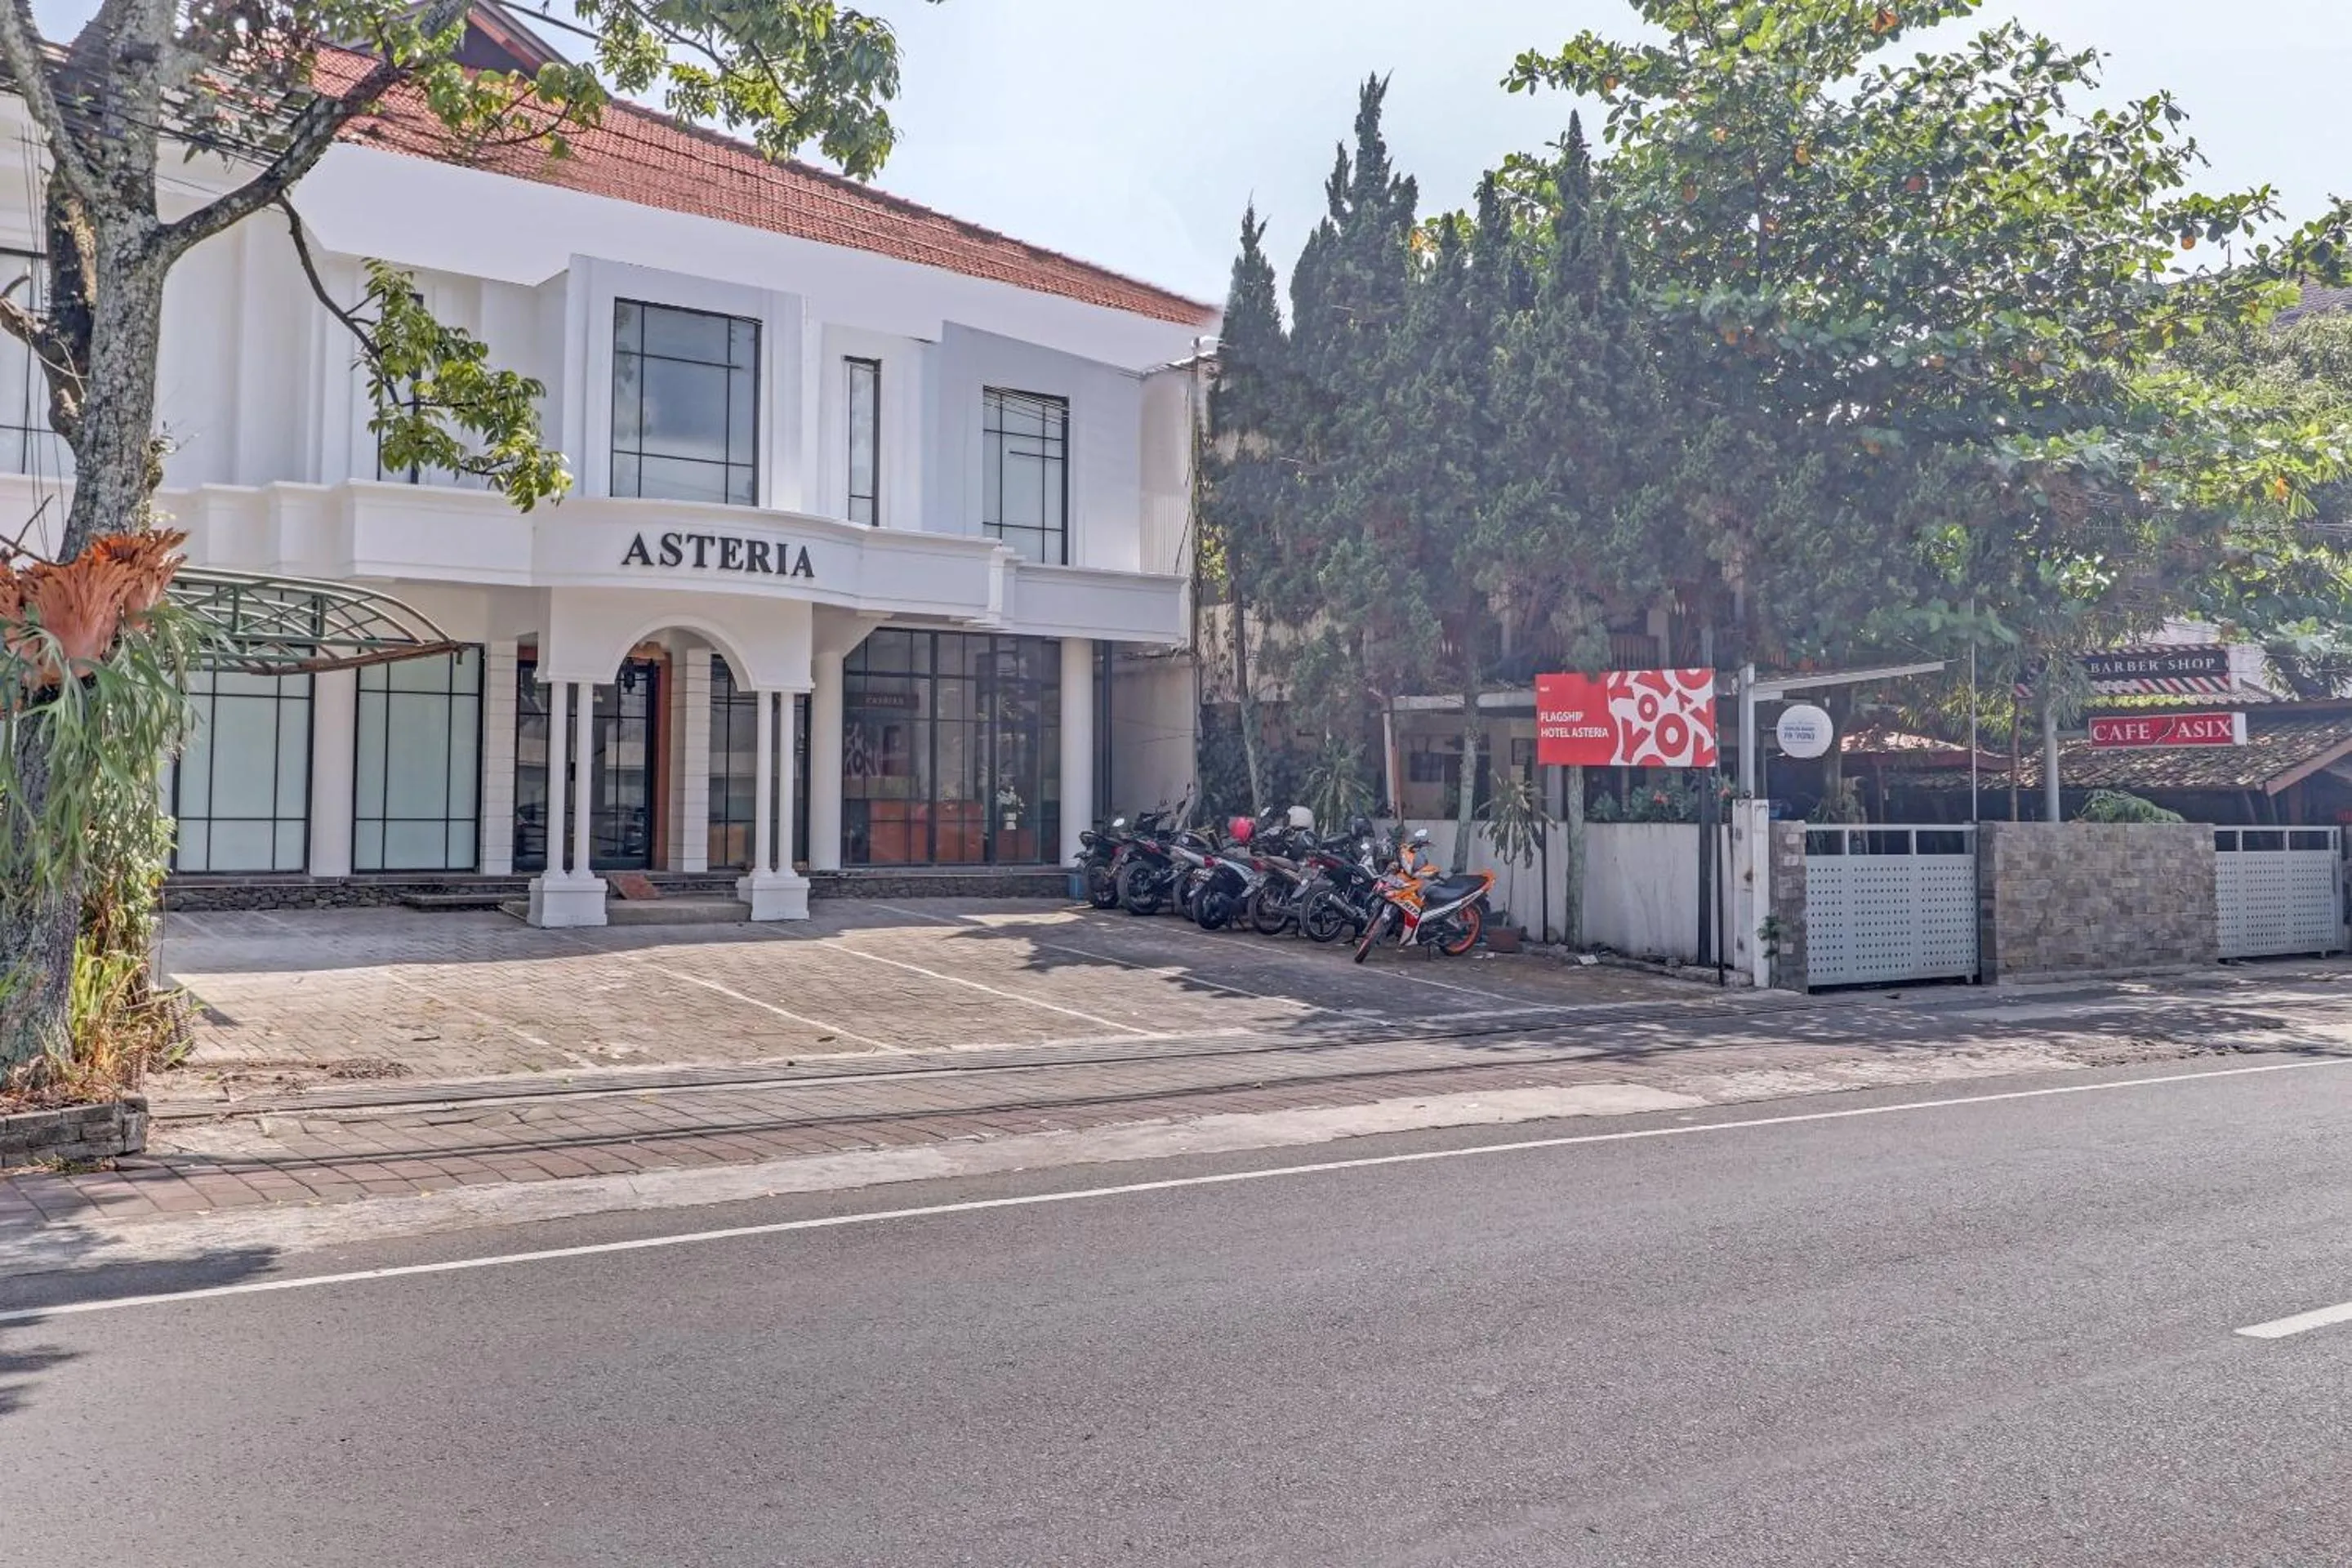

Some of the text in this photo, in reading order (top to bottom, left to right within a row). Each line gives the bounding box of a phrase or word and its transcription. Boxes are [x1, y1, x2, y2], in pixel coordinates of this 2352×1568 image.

[621, 532, 814, 577] ASTERIA
[2091, 657, 2216, 674] BARBER SHOP
[1540, 710, 1584, 723] FLAGSHIP
[1540, 726, 1610, 738] HOTEL ASTERIA
[2092, 719, 2232, 742] CAFE ASIX
